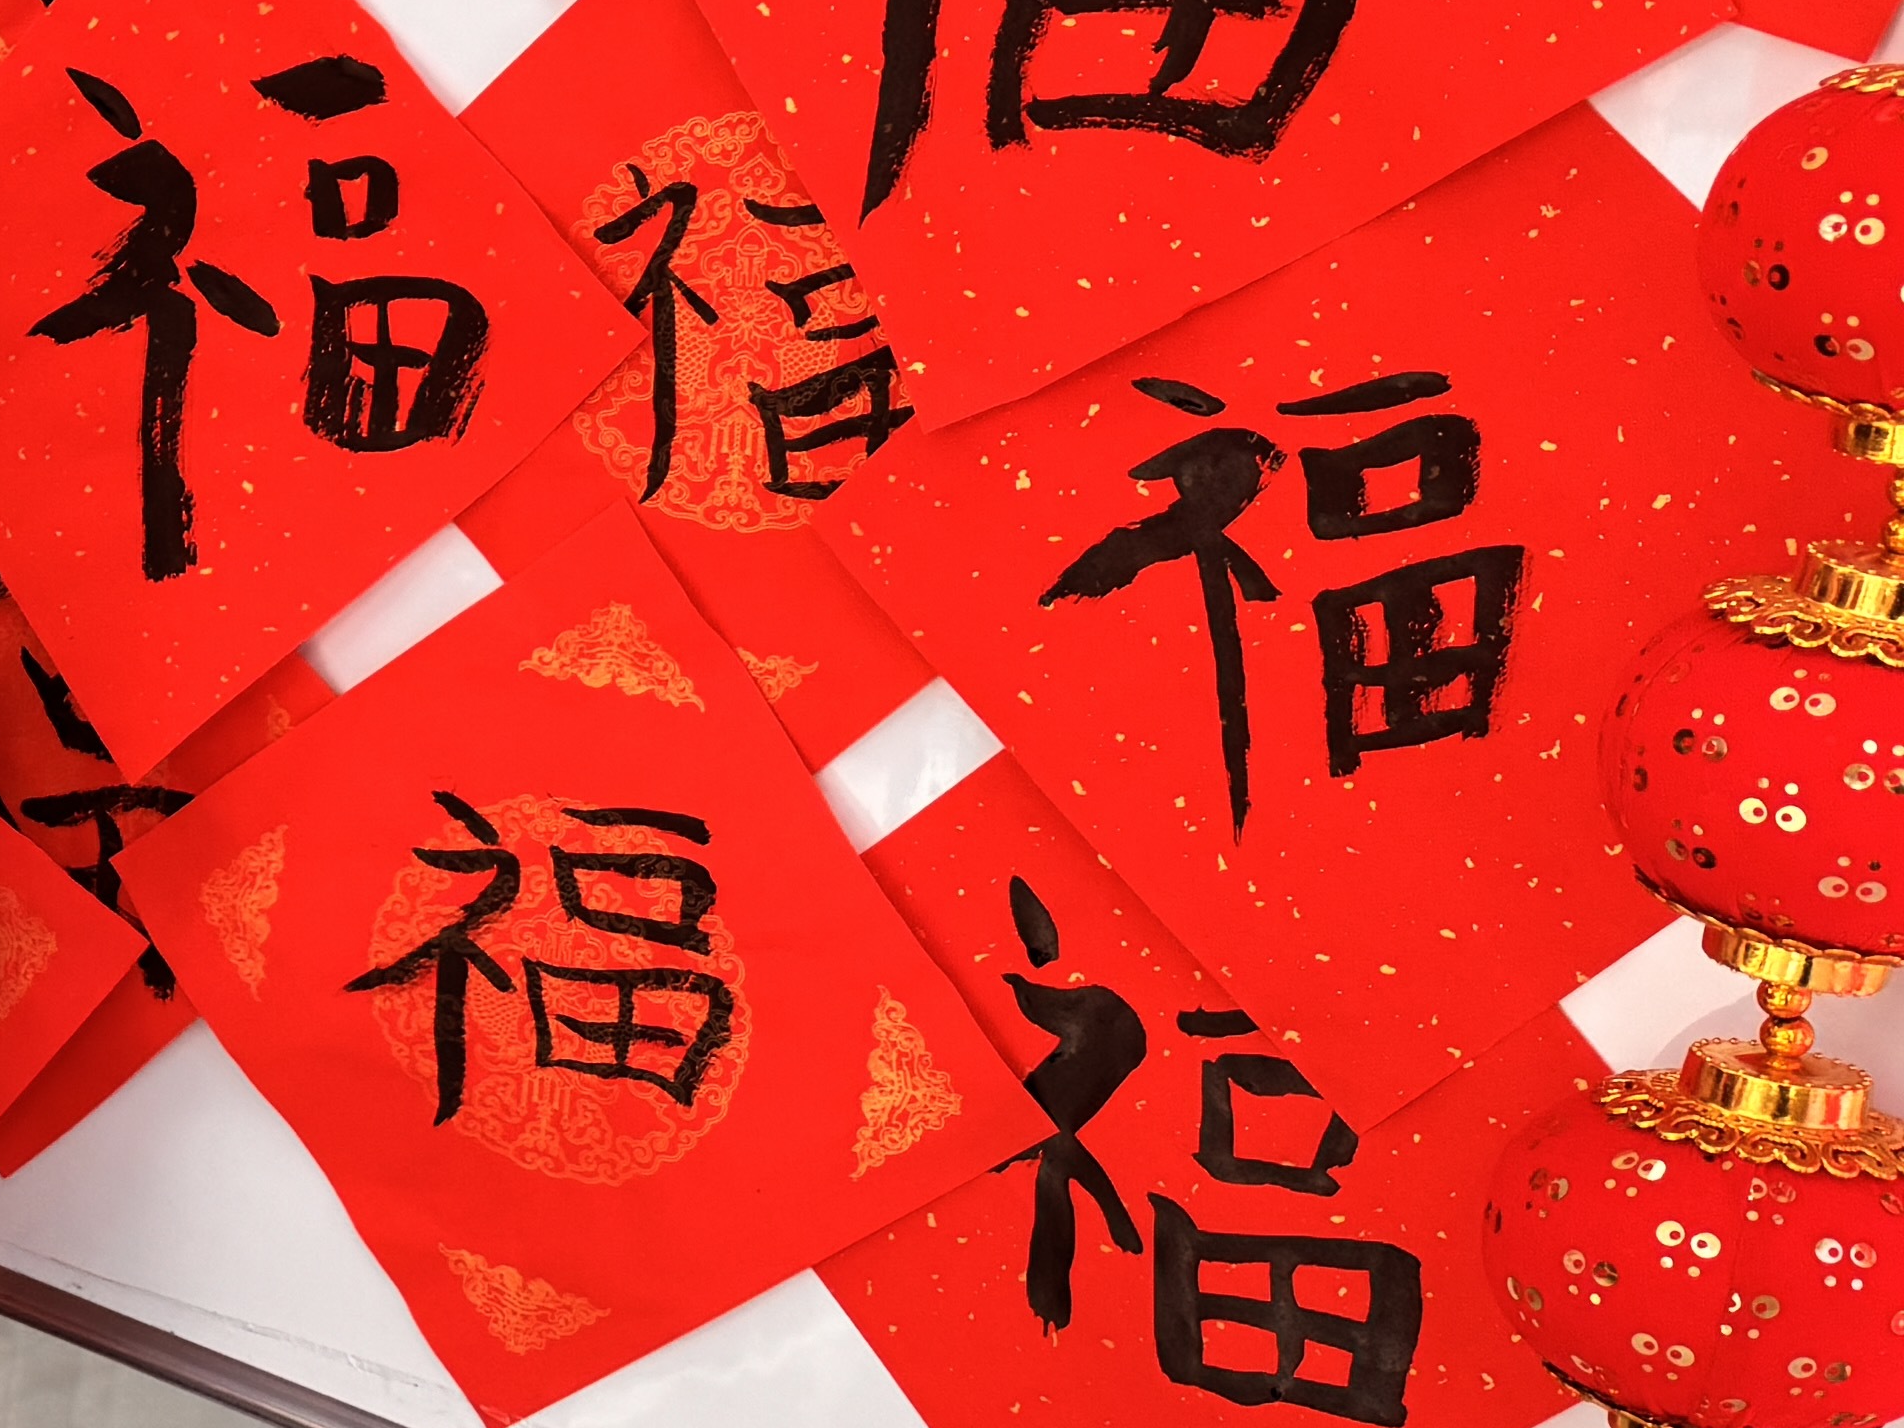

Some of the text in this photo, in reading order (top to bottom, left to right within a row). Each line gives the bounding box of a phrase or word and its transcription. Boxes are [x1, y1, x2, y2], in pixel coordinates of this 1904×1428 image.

[26, 53, 491, 582] 福
[1040, 370, 1527, 841] 福
[344, 789, 736, 1129] 福
